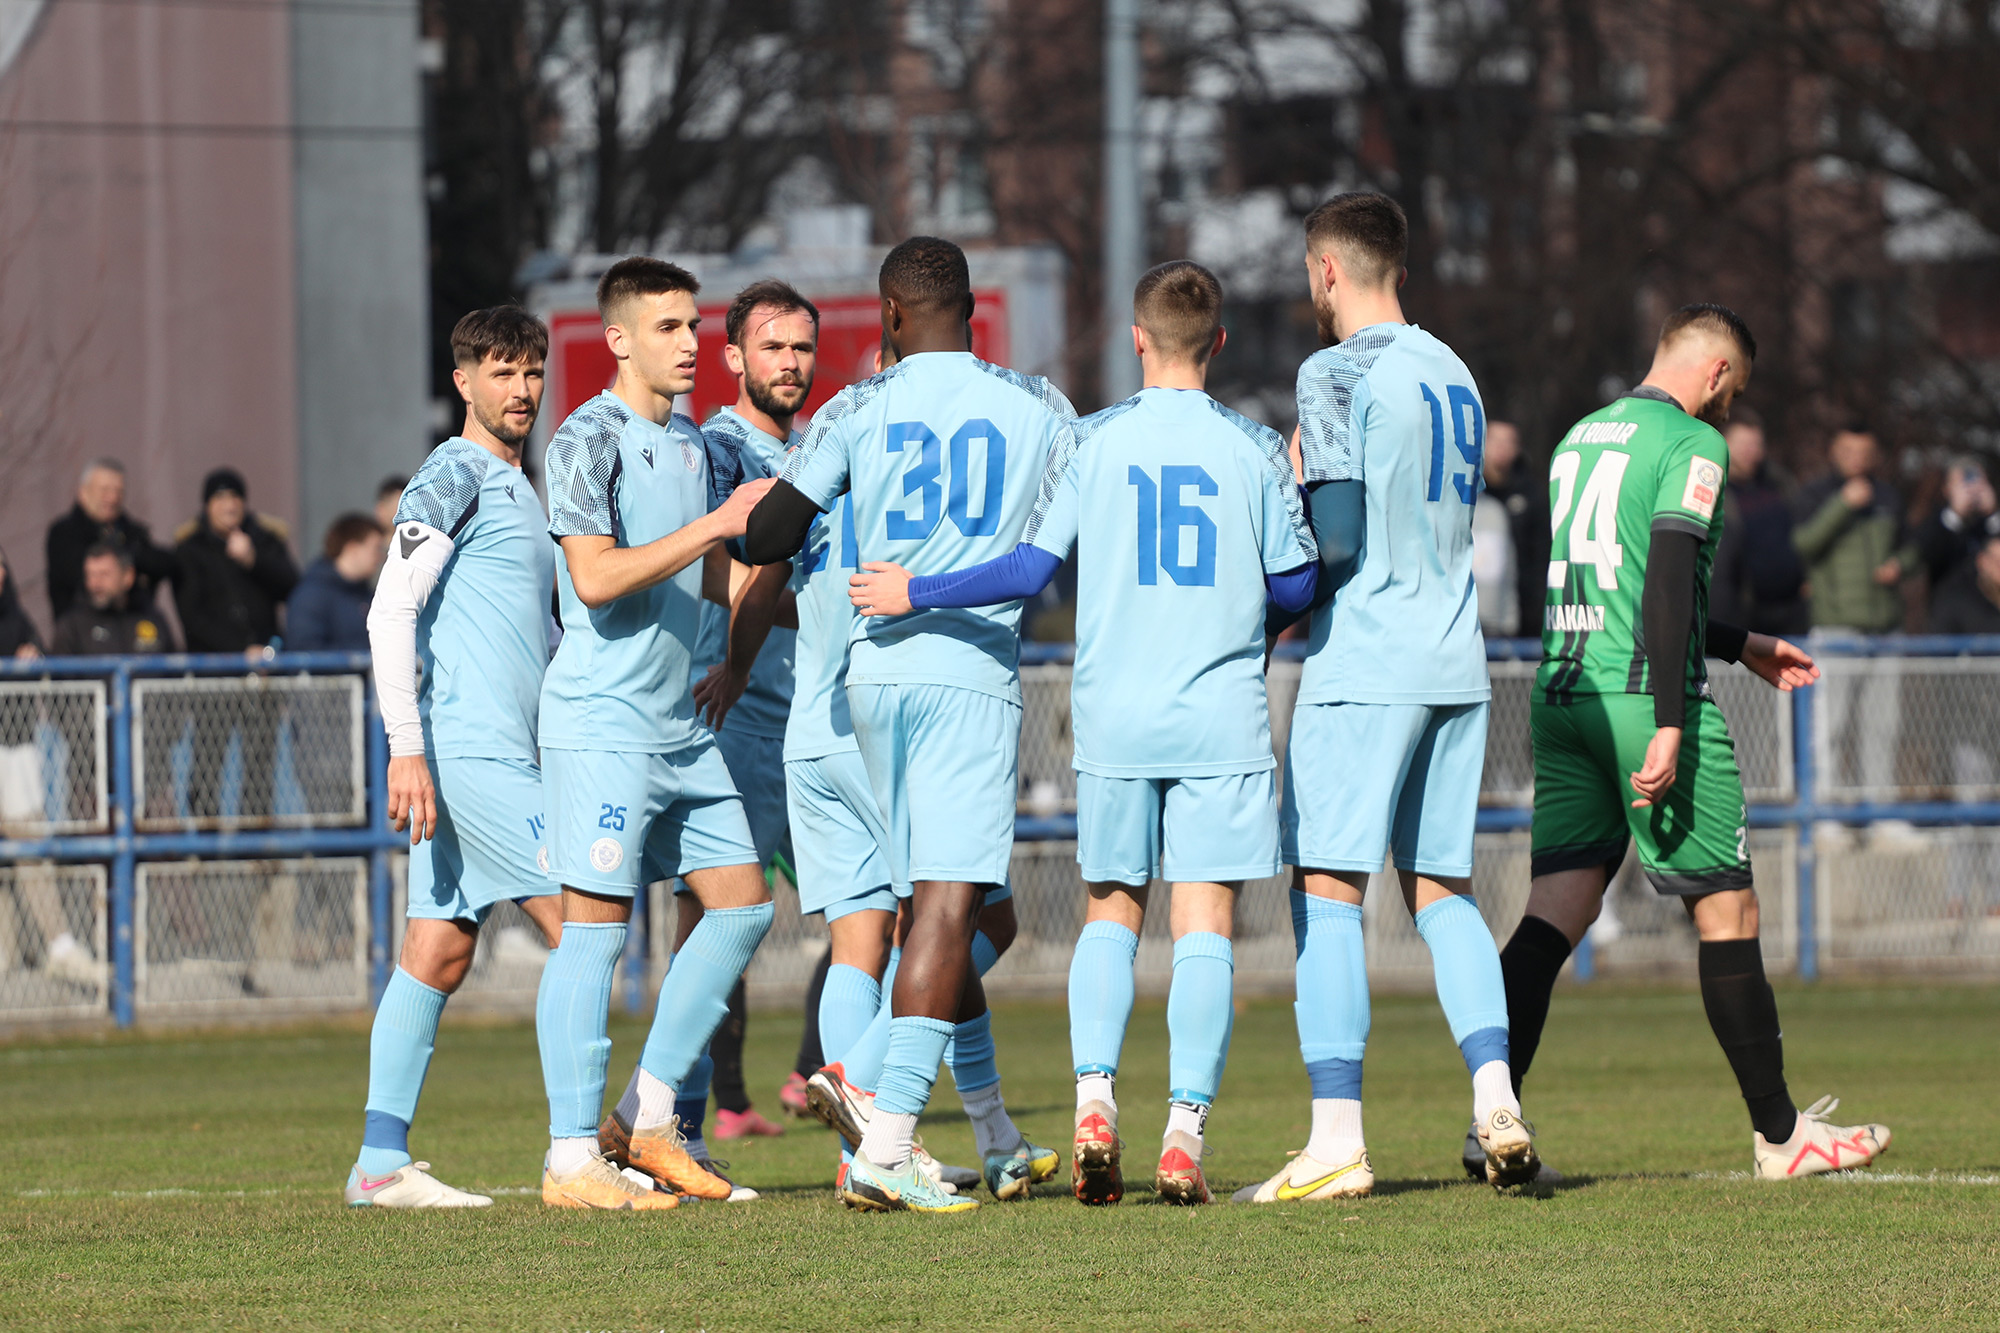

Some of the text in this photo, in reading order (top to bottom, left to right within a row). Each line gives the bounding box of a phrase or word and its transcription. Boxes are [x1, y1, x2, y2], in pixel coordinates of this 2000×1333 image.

[886, 418, 1007, 541] 30
[1419, 382, 1483, 506] 19
[1581, 421, 1639, 446] RUDAR
[1128, 464, 1219, 587] 16
[1547, 450, 1632, 591] 24
[1545, 604, 1605, 632] KAKANJ
[598, 802, 628, 832] 25
